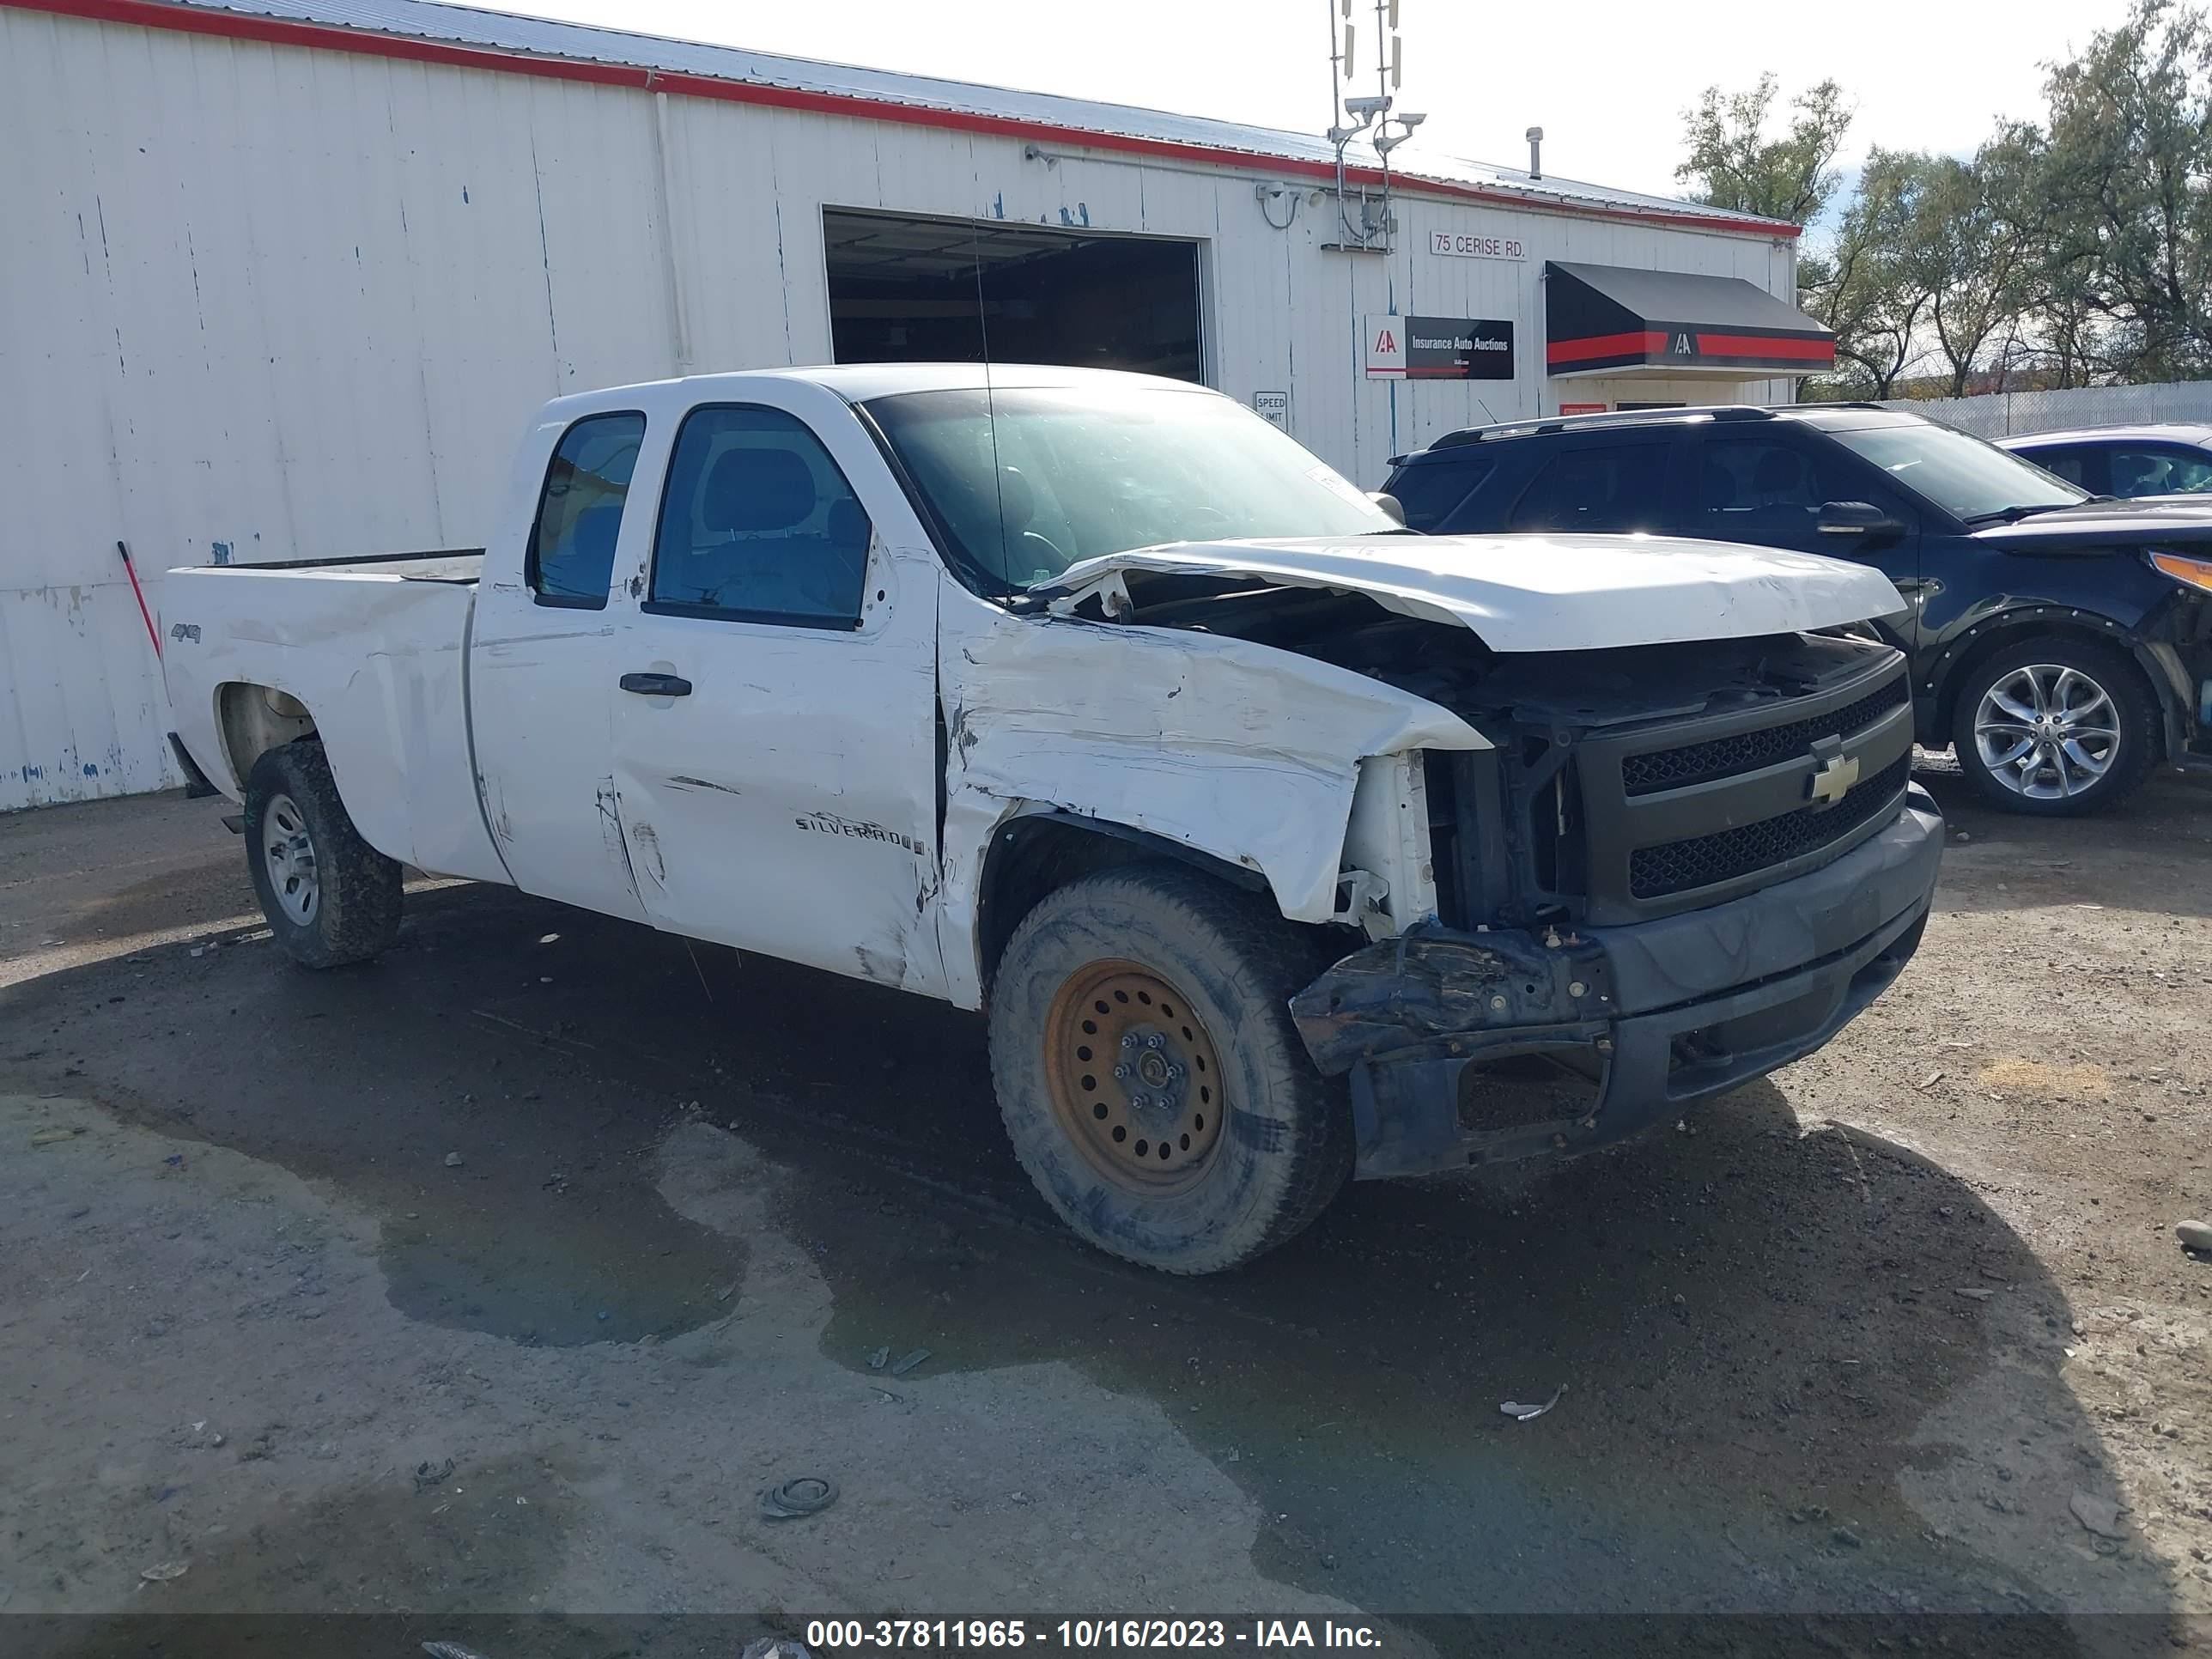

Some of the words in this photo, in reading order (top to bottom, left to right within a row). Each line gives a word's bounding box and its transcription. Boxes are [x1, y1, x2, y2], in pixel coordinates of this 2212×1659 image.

[1436, 234, 1450, 251] 75
[1455, 236, 1501, 255] CERISE
[1505, 240, 1525, 258] RD.
[1413, 335, 1452, 349] Insurance
[1454, 337, 1473, 350] Auto
[1474, 337, 1509, 351] Auctions
[1258, 398, 1285, 408] SPEED
[1261, 412, 1282, 422] IMIT
